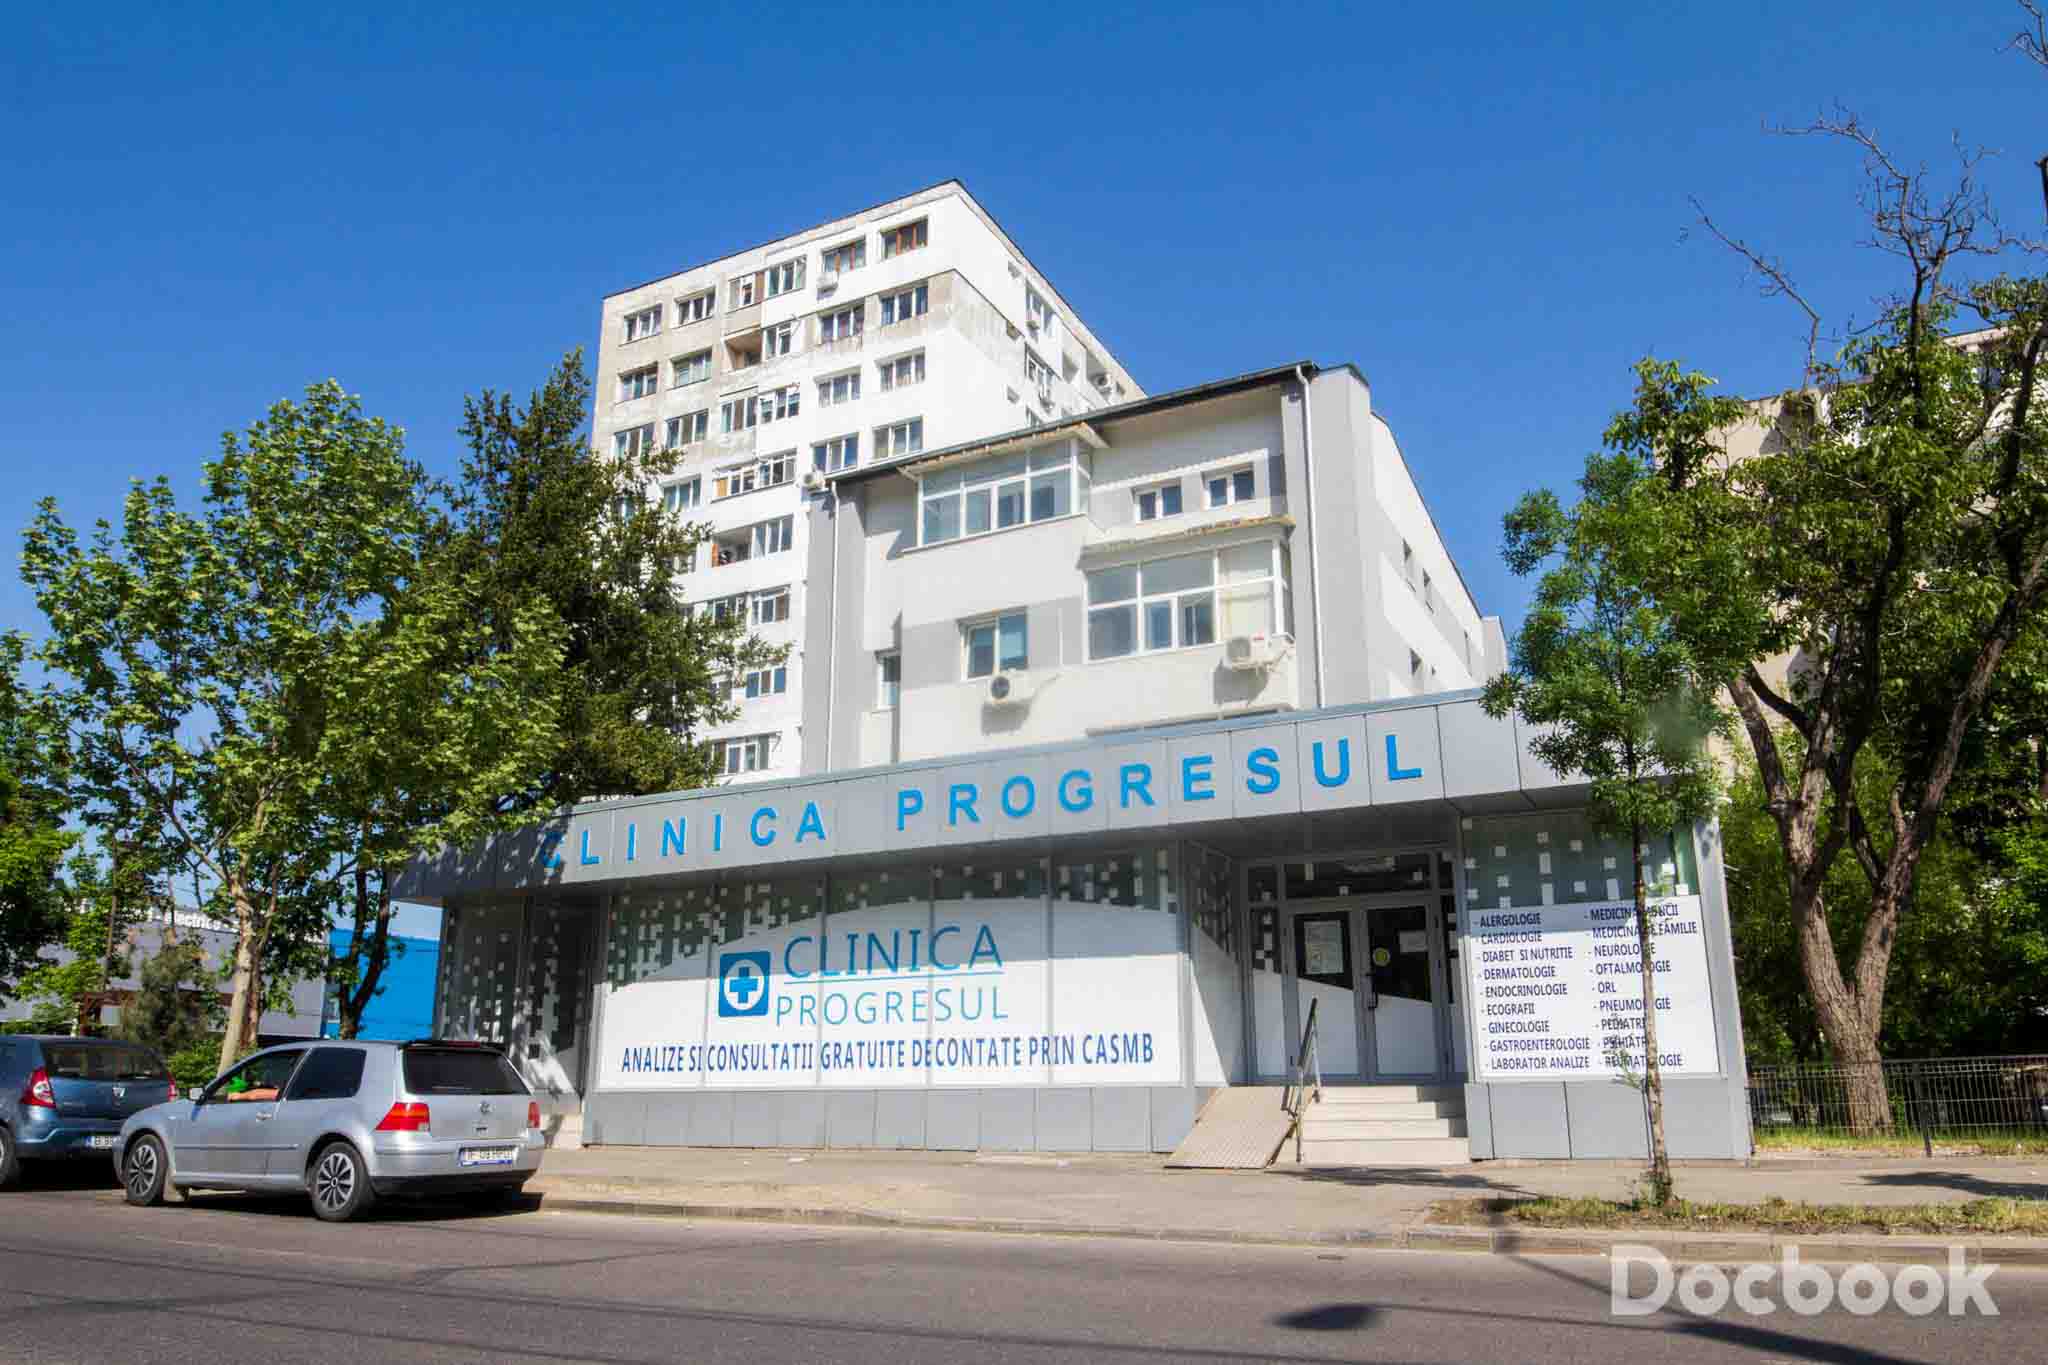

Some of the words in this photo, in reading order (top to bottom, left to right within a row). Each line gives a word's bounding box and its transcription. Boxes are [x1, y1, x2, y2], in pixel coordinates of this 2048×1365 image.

[543, 802, 826, 870] CLINICA
[896, 734, 1424, 830] PROGRESUL
[1480, 912, 1541, 927] ALERGOLOGIE
[1481, 930, 1542, 945] CARDIOLOGIE
[783, 923, 1004, 979] CLINICA
[1483, 949, 1514, 963] DIABET
[1520, 948, 1530, 961] SI
[1531, 946, 1573, 960] NUTRITIE
[1484, 965, 1556, 980] DERMATOLOGIE
[1485, 983, 1568, 998] ENDOCRINOLOGIE
[1598, 982, 1617, 993] ORL
[776, 986, 1009, 1027] PROGRESUL
[1487, 1003, 1535, 1016] ECOGRAFII
[1488, 1020, 1550, 1034] GINECOLOGIE
[622, 1046, 685, 1073] ANALIZE
[689, 1046, 702, 1071] SI
[706, 1042, 813, 1072] CONSULTATII
[820, 1039, 905, 1070] GRATUITE
[912, 1035, 1022, 1067] DECONTATE
[1028, 1034, 1074, 1065] PRIN
[1082, 1031, 1154, 1064] CASMB
[1489, 1038, 1591, 1052] GASTROENTEROLOGIE
[1491, 1058, 1547, 1070] LABORATOR
[1550, 1056, 1591, 1068] ANALIZE
